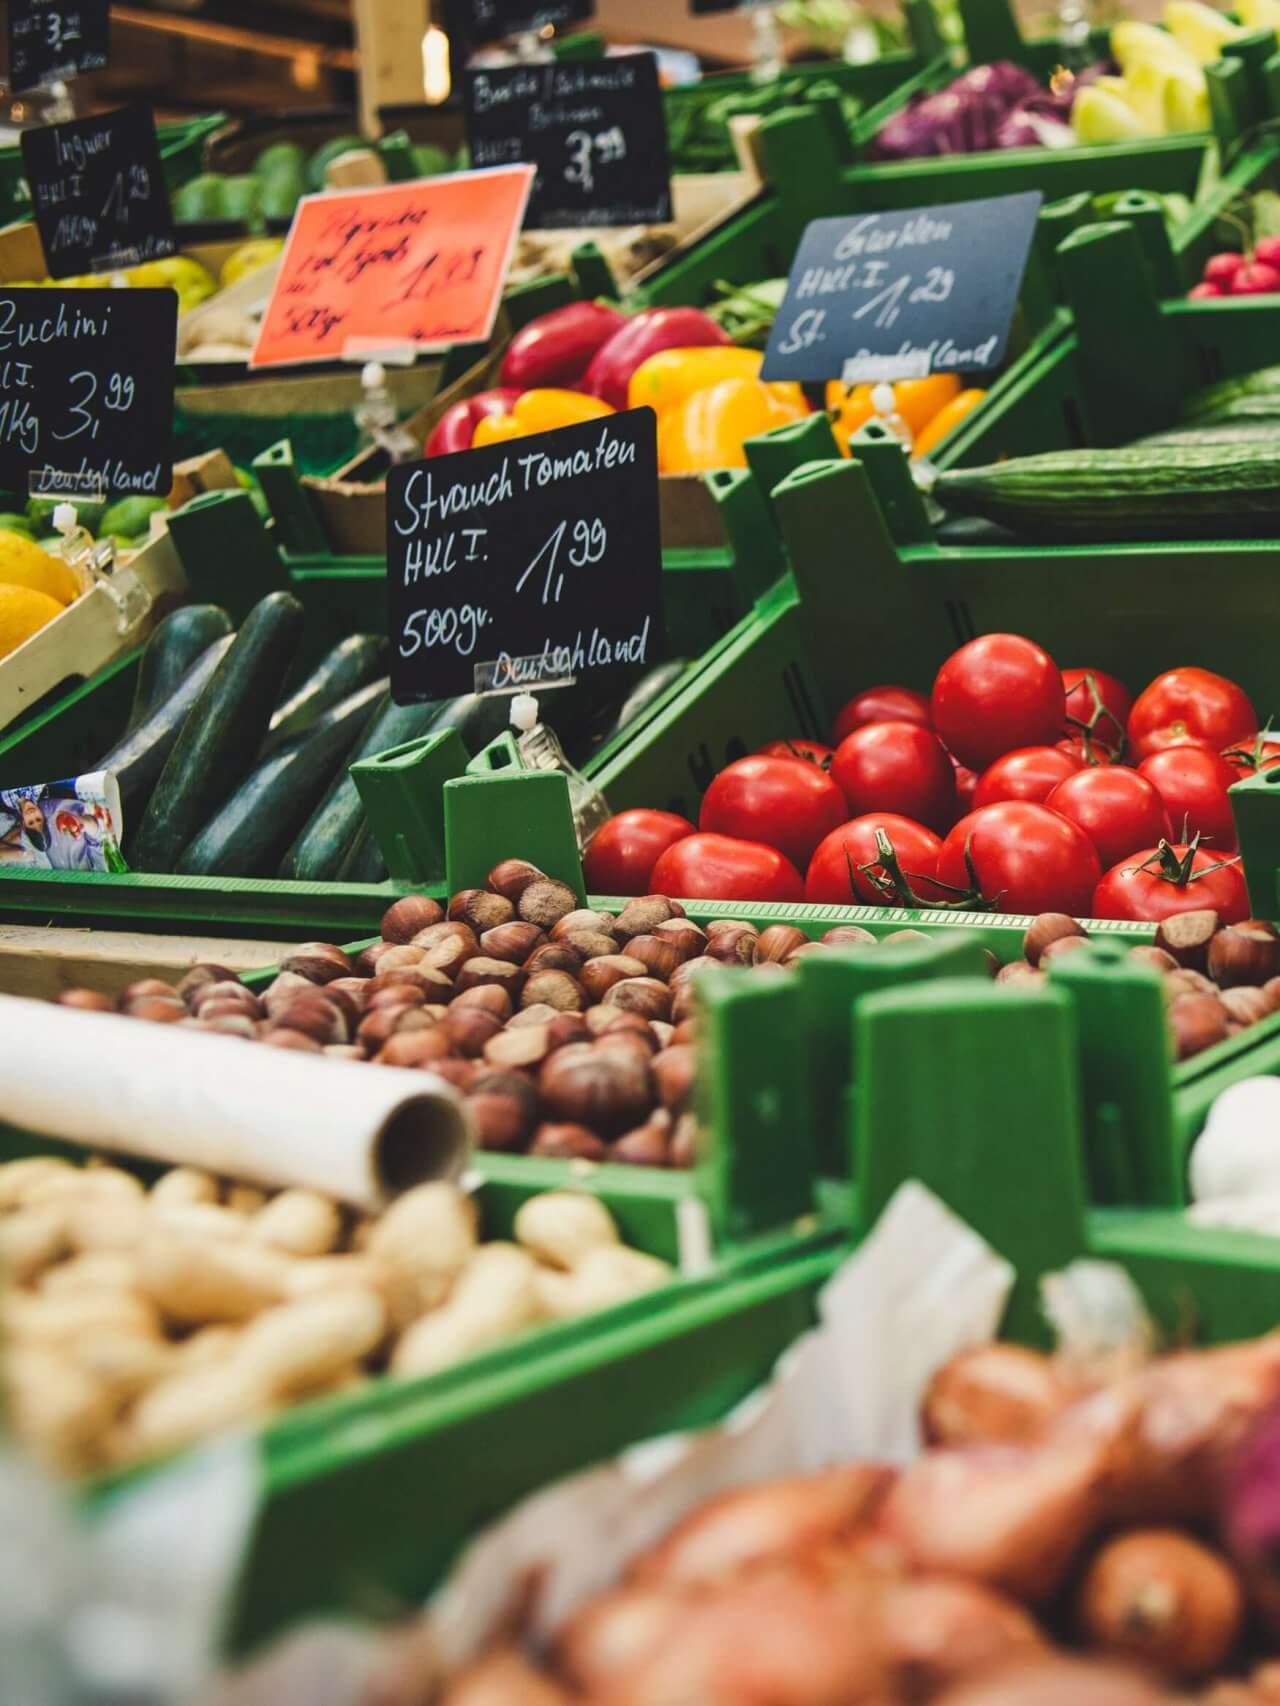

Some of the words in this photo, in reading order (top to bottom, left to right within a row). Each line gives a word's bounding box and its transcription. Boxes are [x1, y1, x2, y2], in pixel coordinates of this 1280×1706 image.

[834, 214, 952, 260] Gurken
[38, 457, 160, 490] Deutschland
[395, 457, 512, 534] Strauch
[517, 427, 635, 490] Tomaten
[492, 616, 649, 687] Deutschland
